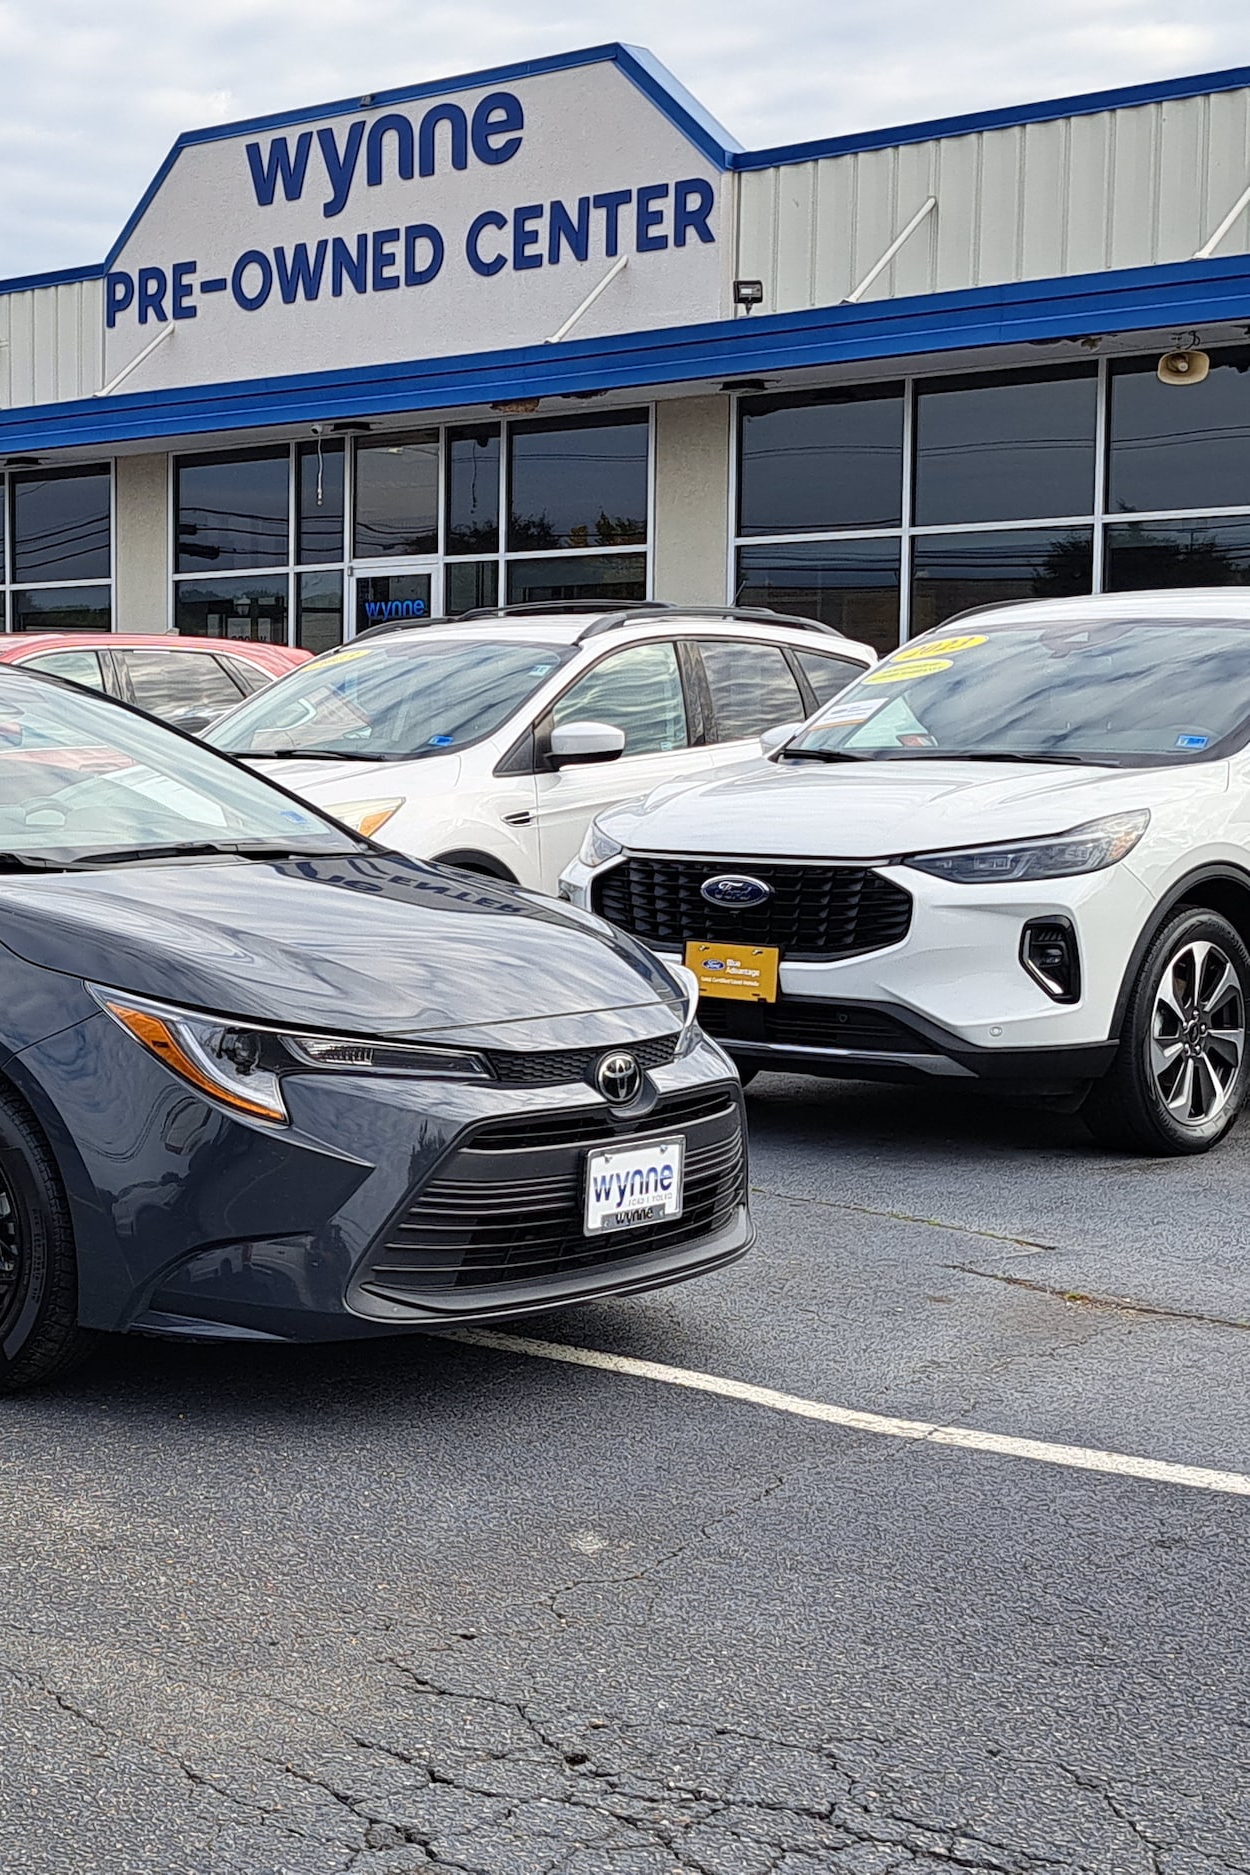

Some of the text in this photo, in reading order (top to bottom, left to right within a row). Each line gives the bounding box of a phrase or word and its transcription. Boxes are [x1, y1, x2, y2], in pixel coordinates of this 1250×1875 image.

[245, 92, 524, 218] wynne
[106, 178, 715, 328] PRE-OWNED CENTER
[365, 599, 425, 621] wynne
[593, 1164, 674, 1209] wynne
[615, 1207, 654, 1227] wynne
